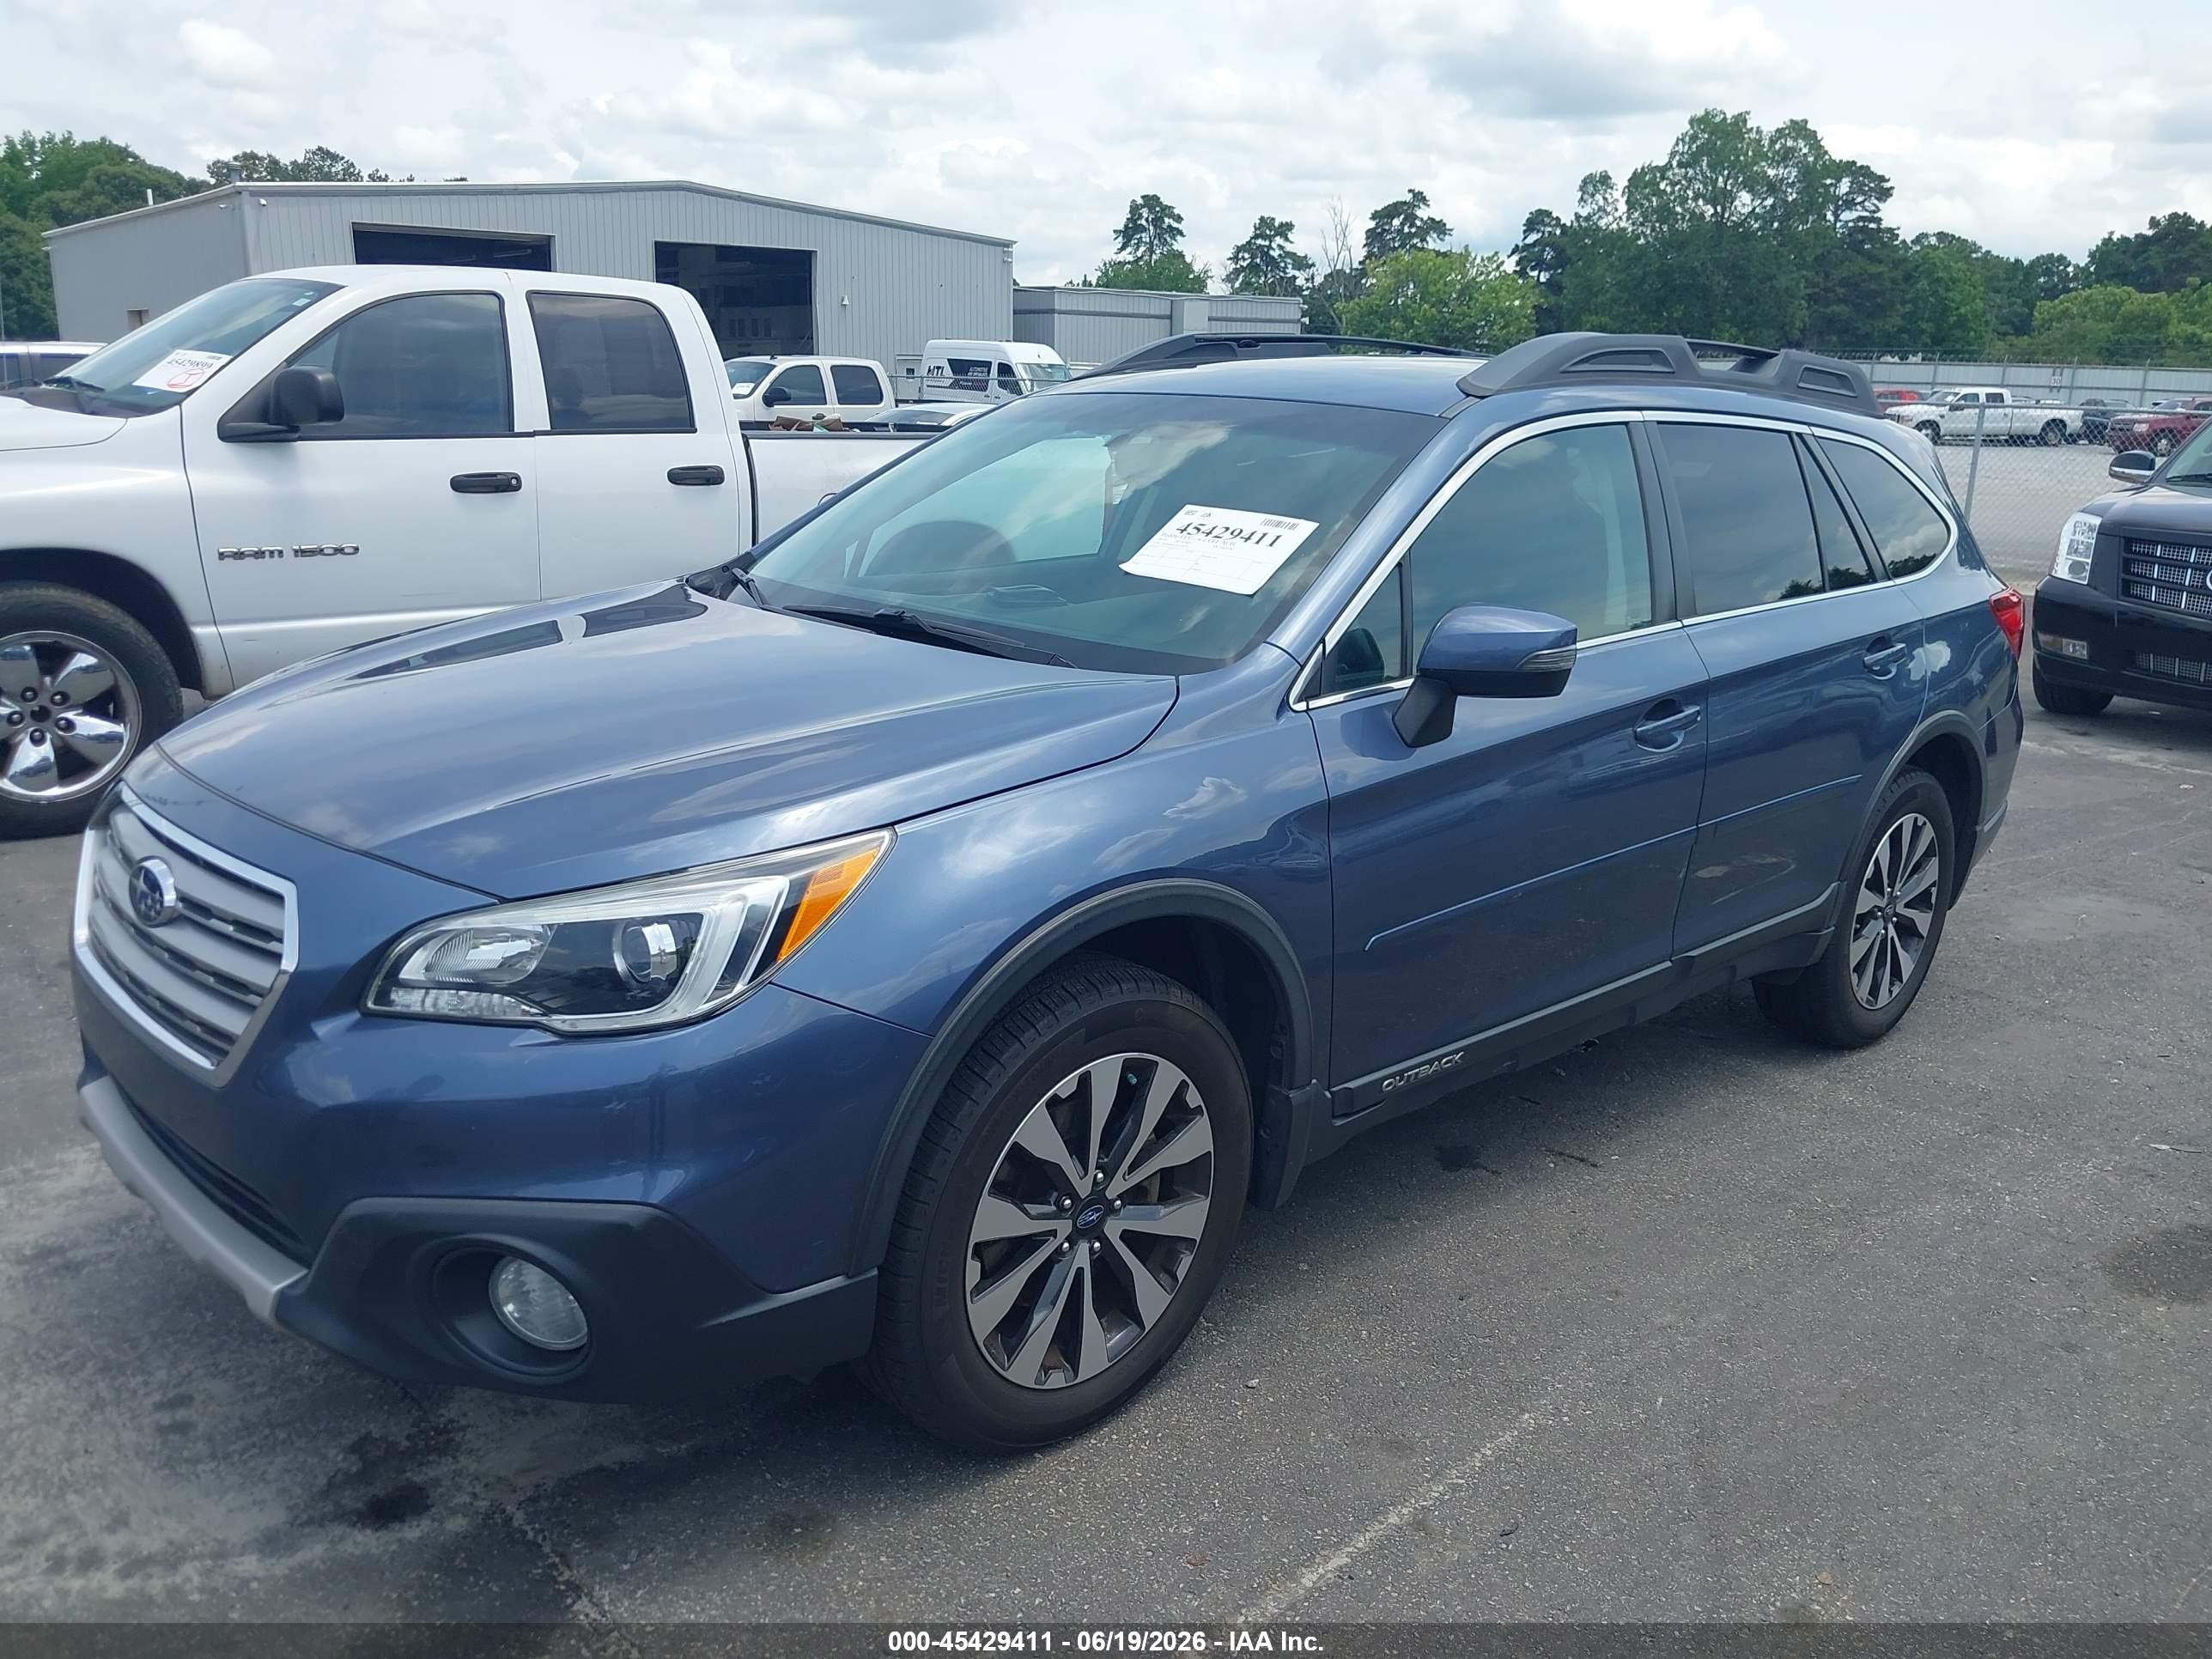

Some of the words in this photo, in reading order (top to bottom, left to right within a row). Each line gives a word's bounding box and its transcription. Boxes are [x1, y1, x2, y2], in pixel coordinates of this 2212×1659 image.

[1176, 522, 1283, 548] 45429411
[218, 547, 283, 560] RAM
[292, 544, 359, 557] 1500
[1382, 1051, 1464, 1092] OUTBACK
